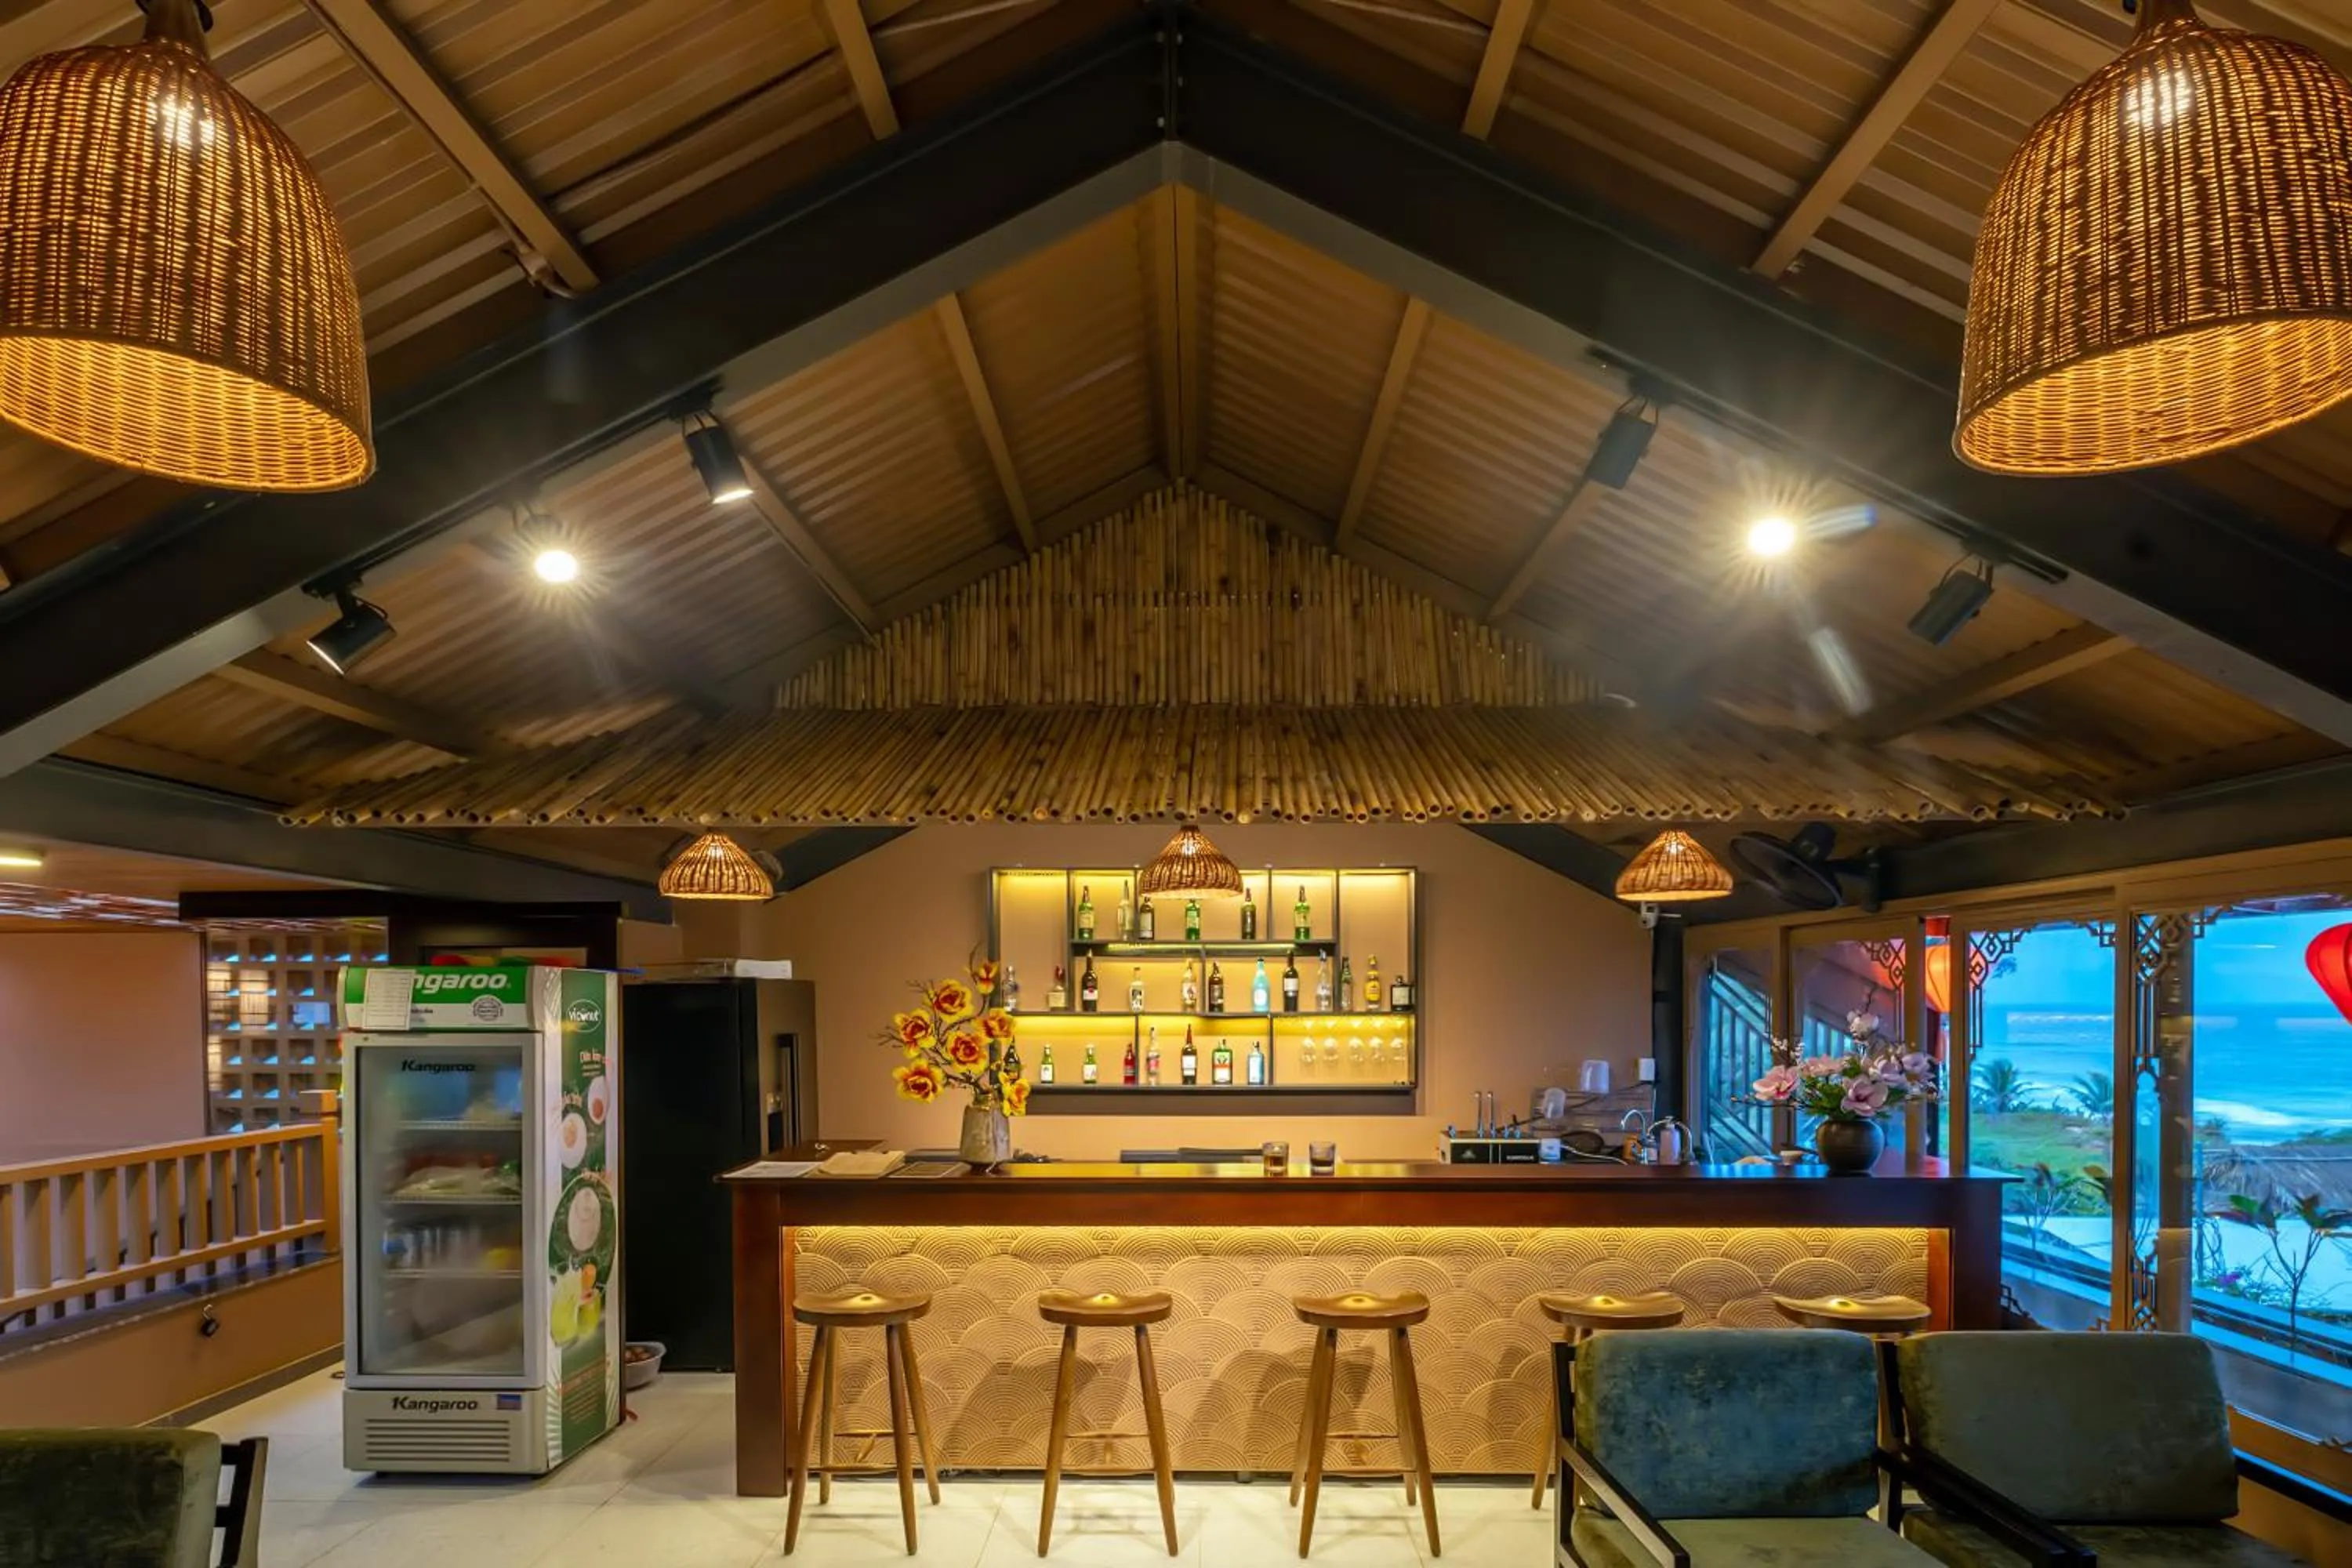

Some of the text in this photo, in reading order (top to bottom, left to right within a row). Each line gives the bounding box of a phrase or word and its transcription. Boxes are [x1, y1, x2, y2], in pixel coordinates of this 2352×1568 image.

[413, 973, 508, 994] ngaroo
[401, 1059, 476, 1075] Kangaroo
[393, 1396, 478, 1414] Kangaroo
